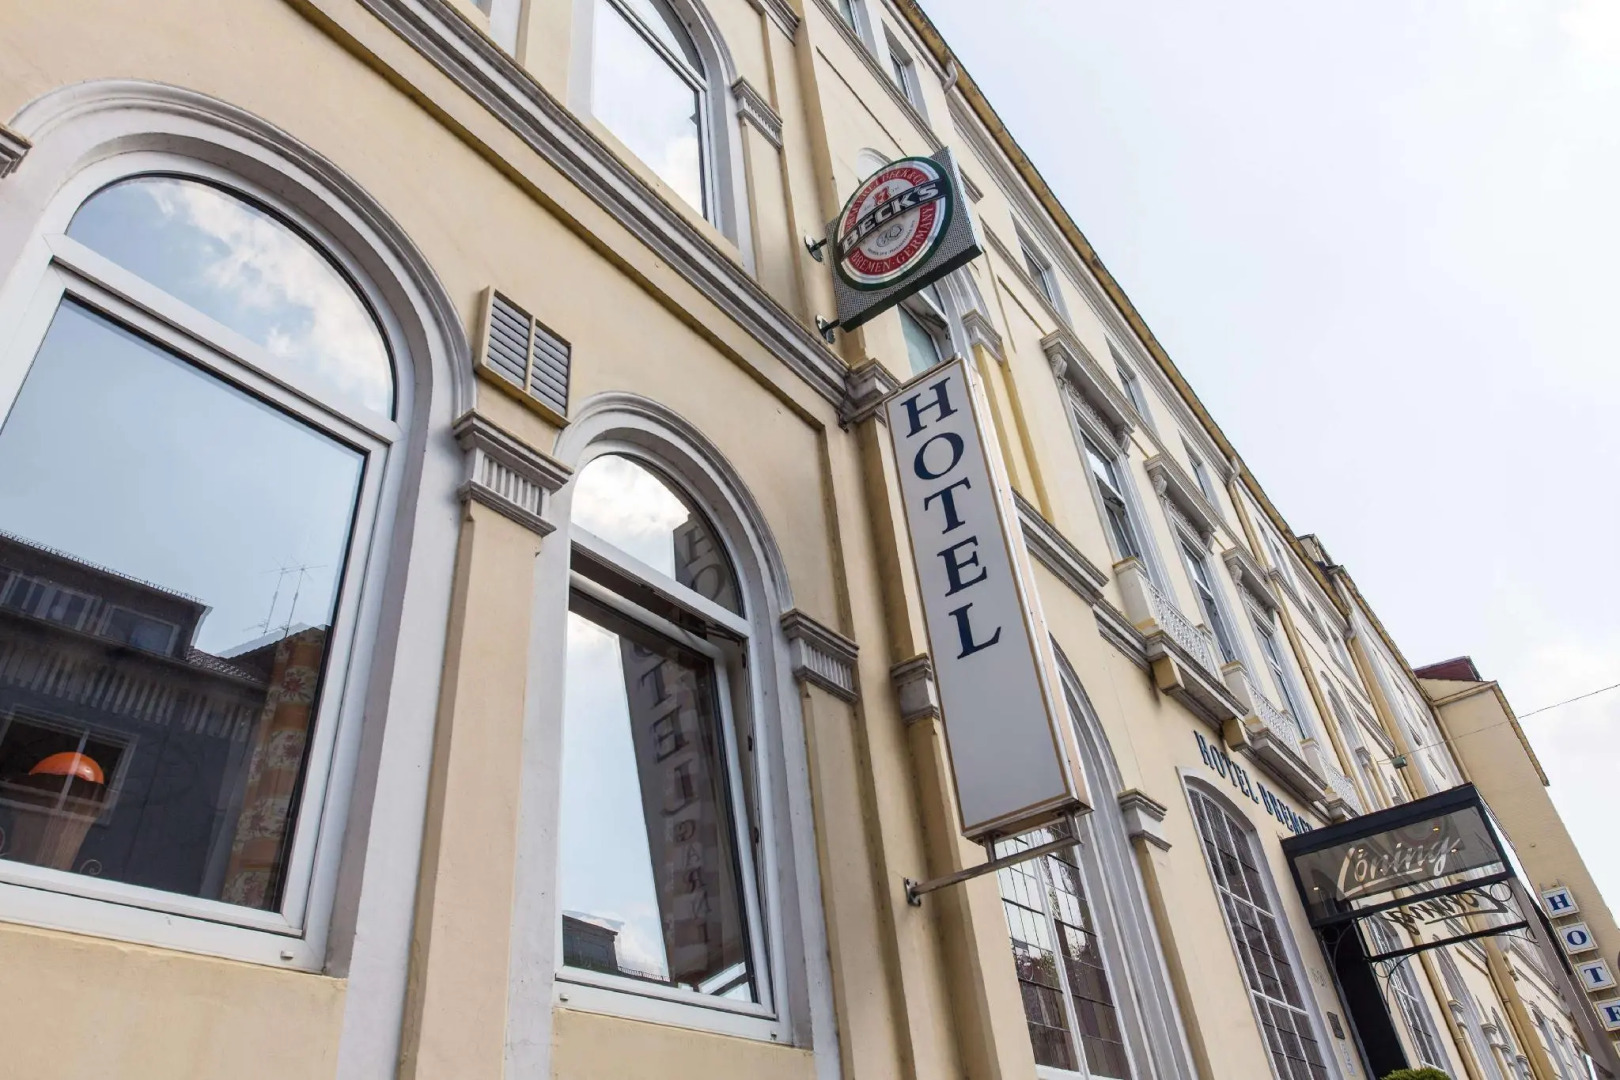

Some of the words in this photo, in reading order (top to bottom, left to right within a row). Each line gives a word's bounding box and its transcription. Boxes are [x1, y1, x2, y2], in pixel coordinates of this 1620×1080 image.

[851, 250, 890, 272] BREMEN
[896, 207, 934, 264] GERMANY
[901, 376, 1001, 659] HOTEL
[1193, 730, 1259, 804] HOTEL
